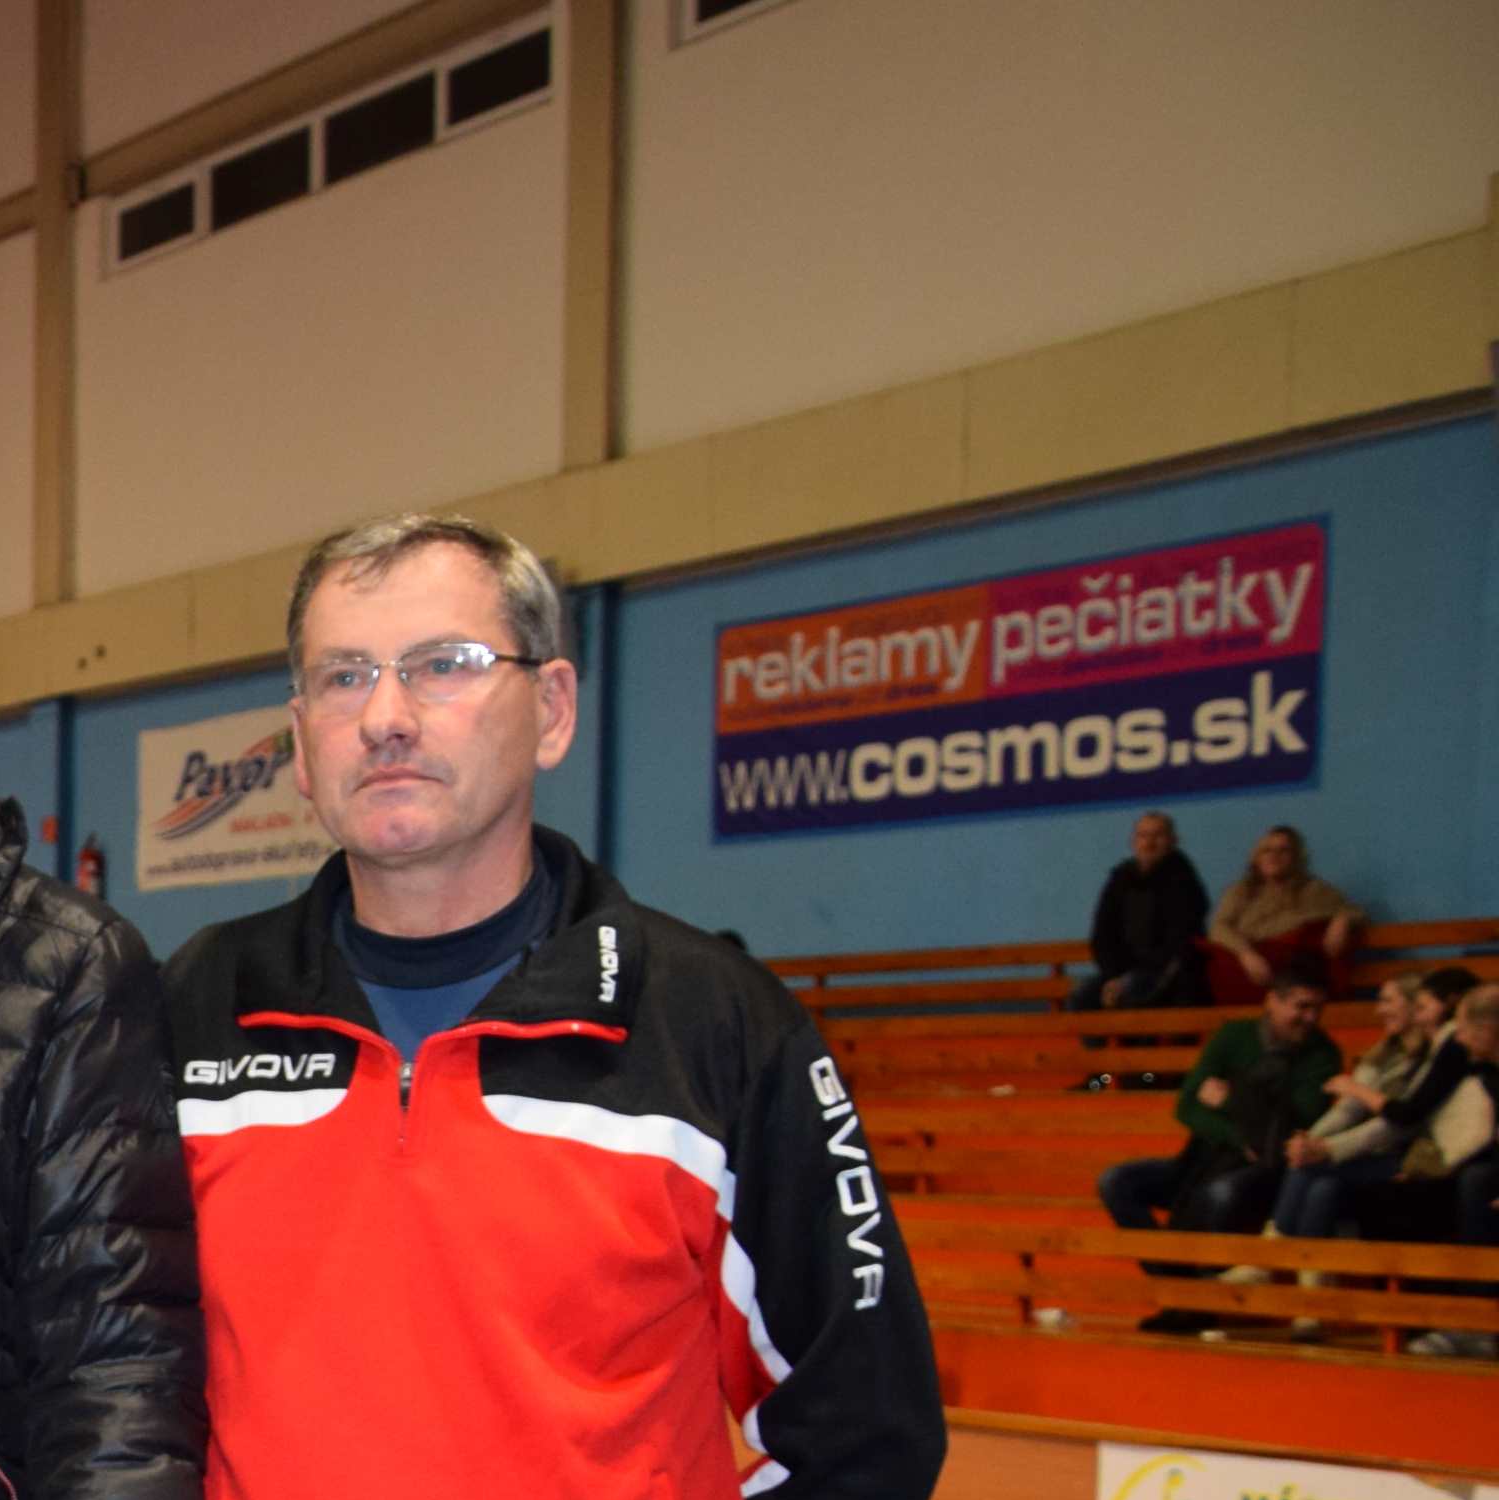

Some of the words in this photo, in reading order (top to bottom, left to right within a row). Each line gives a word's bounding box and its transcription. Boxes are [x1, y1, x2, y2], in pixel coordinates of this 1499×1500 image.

[722, 619, 981, 705] reklamy
[992, 556, 1314, 686] pečiatky
[718, 670, 1307, 813] www.cosmos.sk
[598, 925, 619, 1003] GIVOVA
[183, 1053, 336, 1085] GIVOVA
[808, 1056, 884, 1311] GIVOVA
